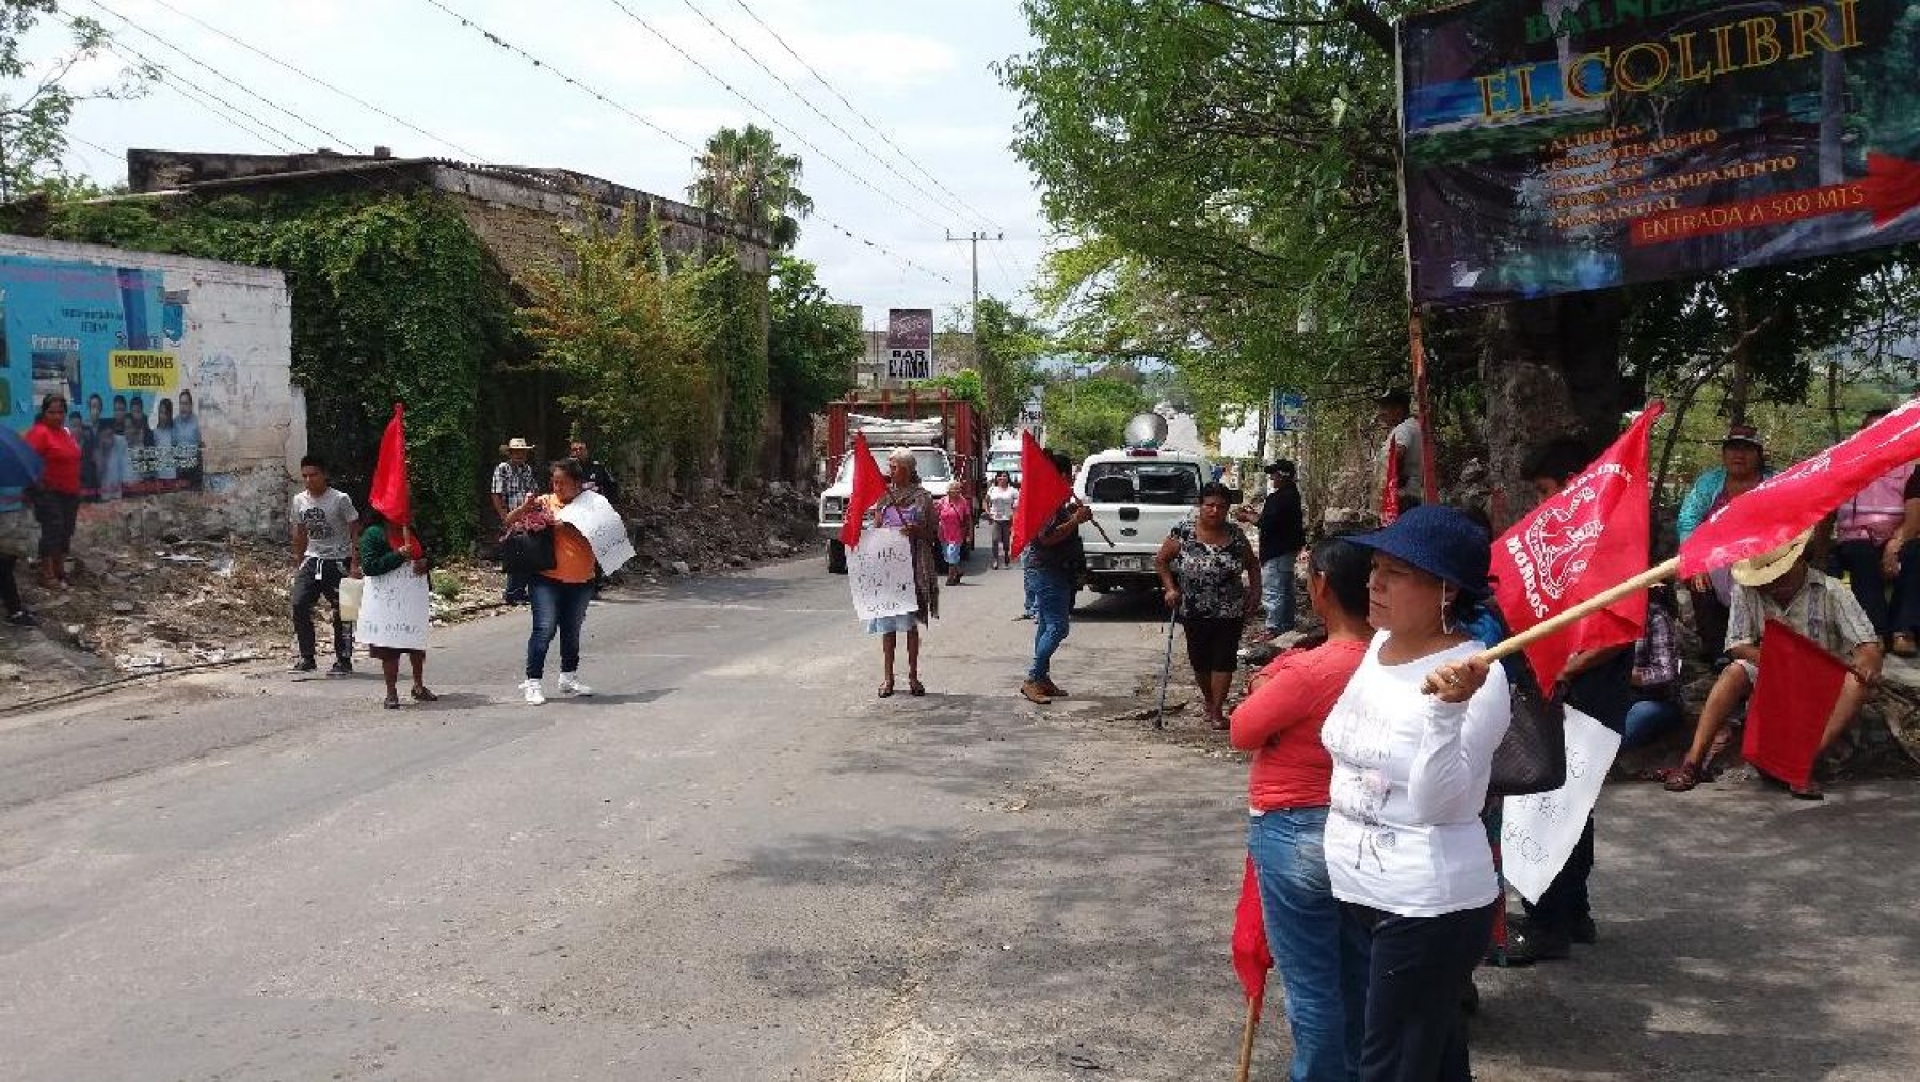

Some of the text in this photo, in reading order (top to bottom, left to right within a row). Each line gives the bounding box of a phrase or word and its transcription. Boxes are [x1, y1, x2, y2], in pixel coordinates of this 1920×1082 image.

[1474, 0, 1863, 125] EL COLIBRI
[1649, 156, 1797, 192] CAMPAMENTO
[1556, 196, 1681, 229] MANANTIAL
[1641, 184, 1864, 239] ENTRADA A 500 MTS
[1505, 535, 1550, 619] MORELOS
